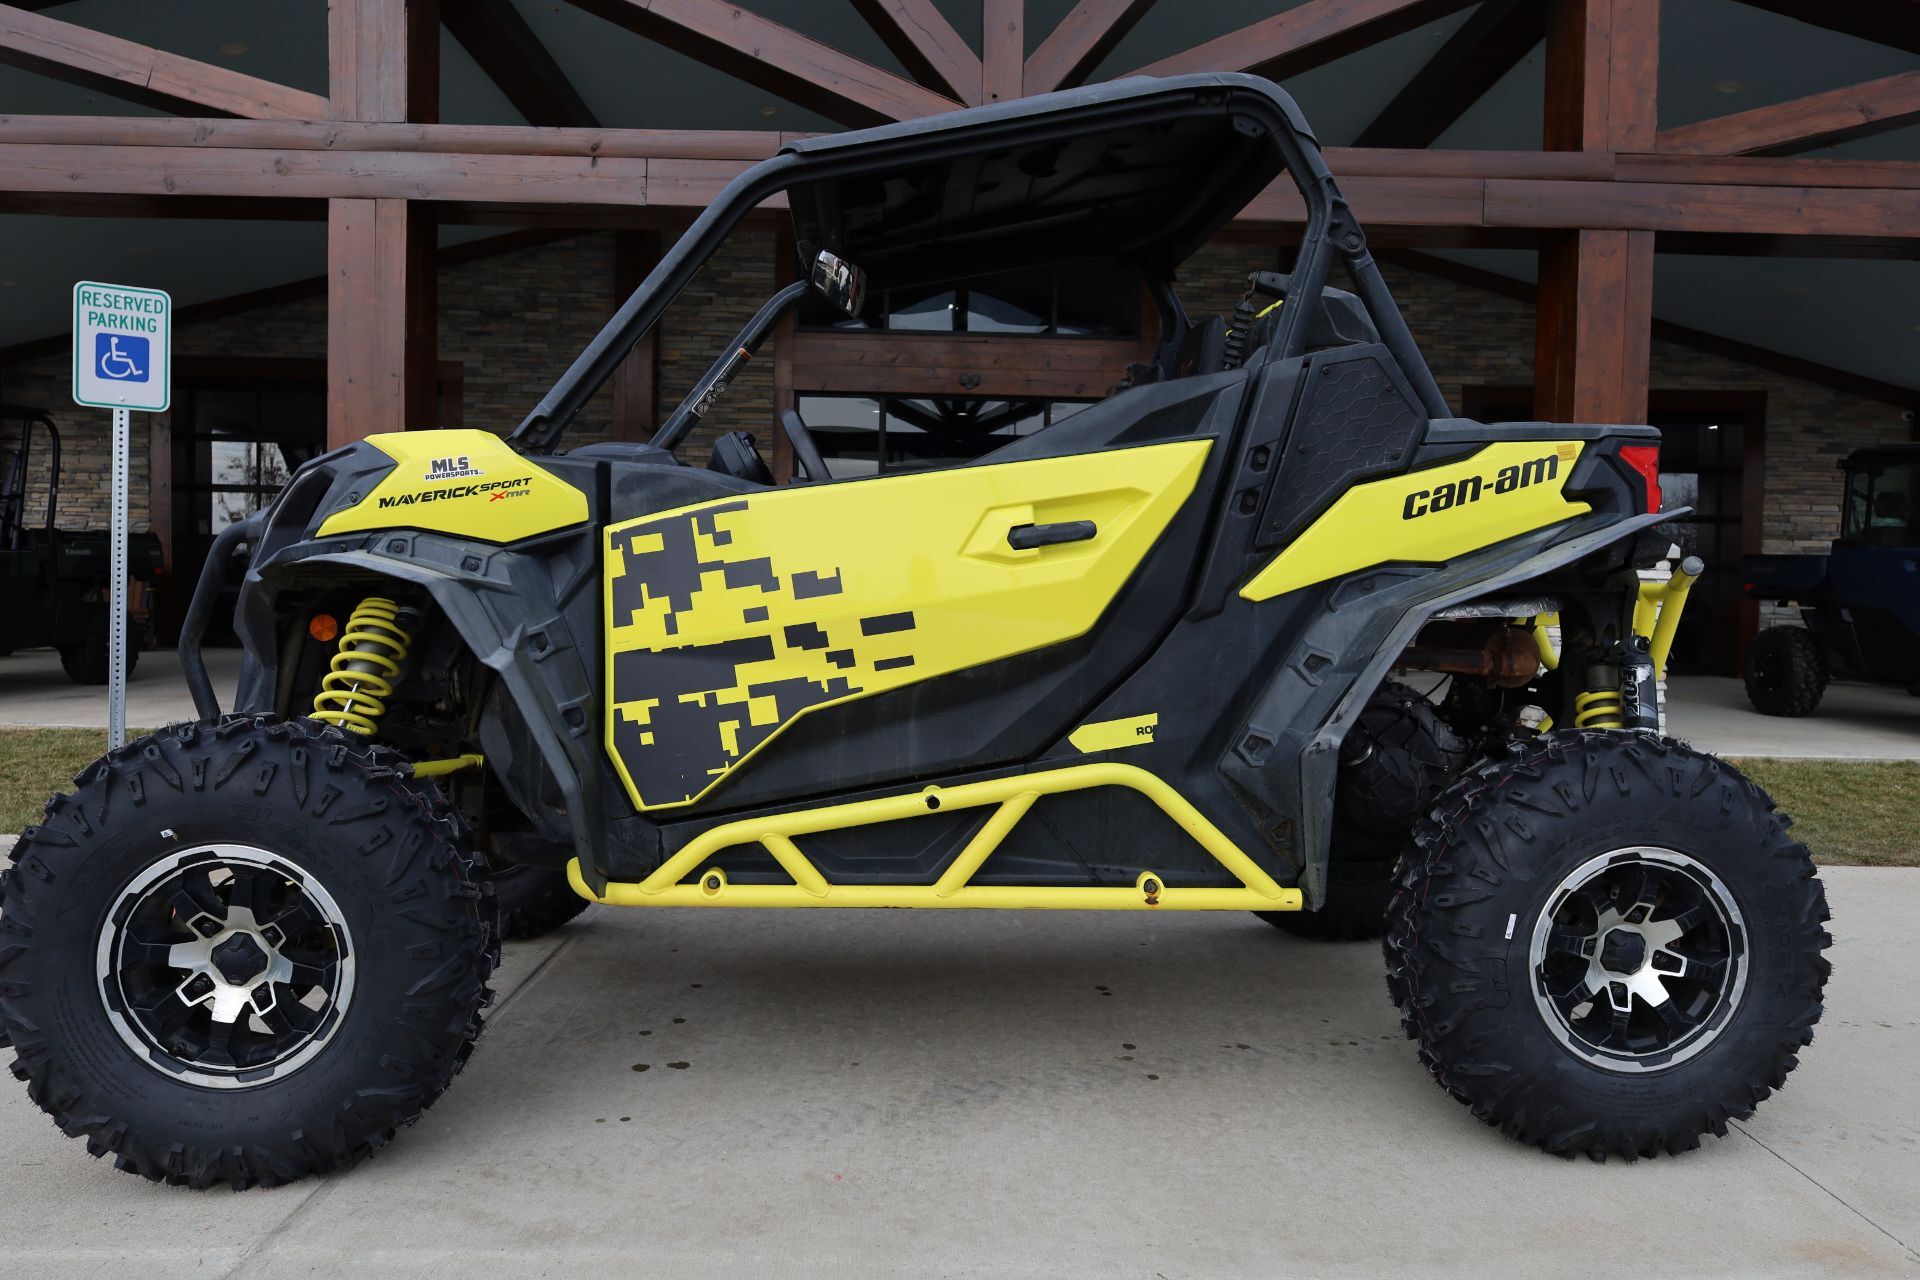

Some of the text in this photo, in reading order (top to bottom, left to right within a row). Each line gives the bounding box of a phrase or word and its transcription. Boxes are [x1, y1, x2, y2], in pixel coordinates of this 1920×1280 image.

[81, 290, 164, 315] RESERVED
[88, 310, 157, 334] PARKING
[424, 469, 479, 480] POWERSPORTS
[431, 456, 469, 473] MLS
[1402, 454, 1559, 520] can-am
